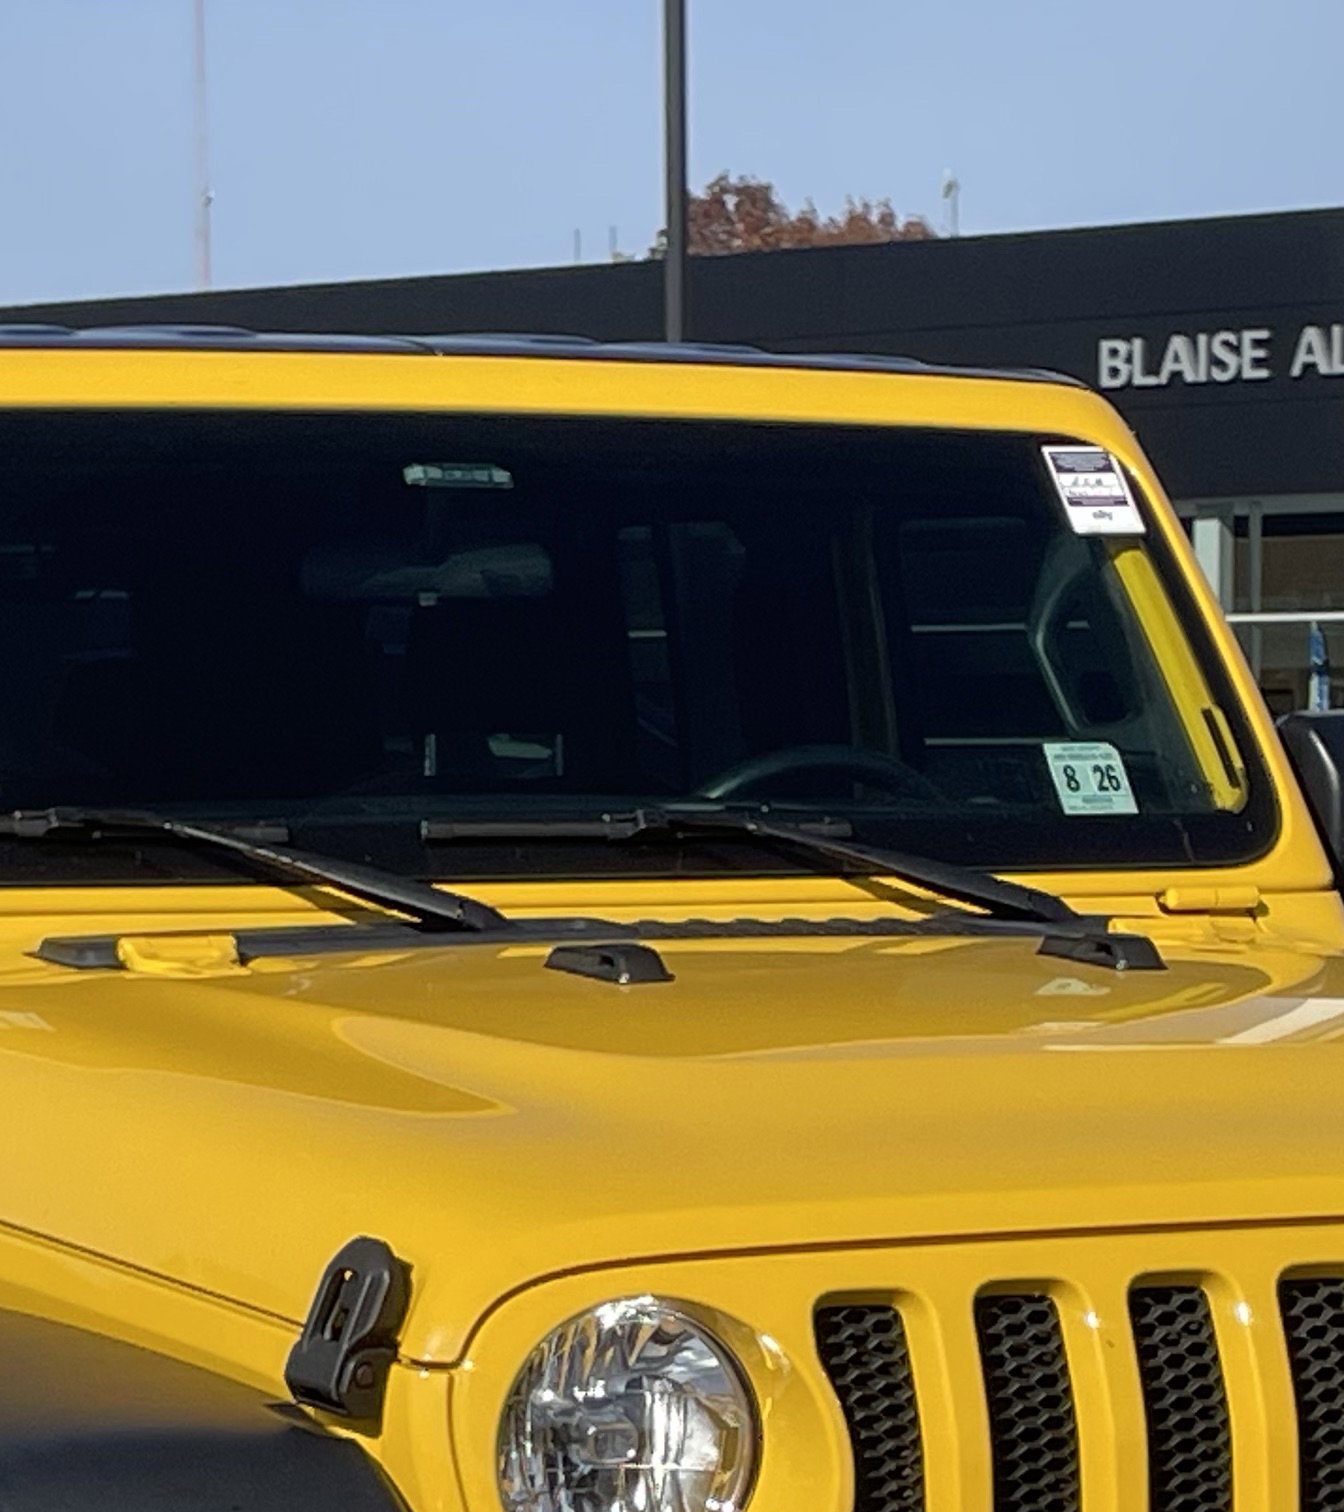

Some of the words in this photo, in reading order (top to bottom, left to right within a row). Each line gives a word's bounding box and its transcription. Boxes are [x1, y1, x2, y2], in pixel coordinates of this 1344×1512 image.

[1098, 327, 1271, 389] BLAISE
[1063, 764, 1081, 792] 8
[1092, 764, 1121, 792] 26
